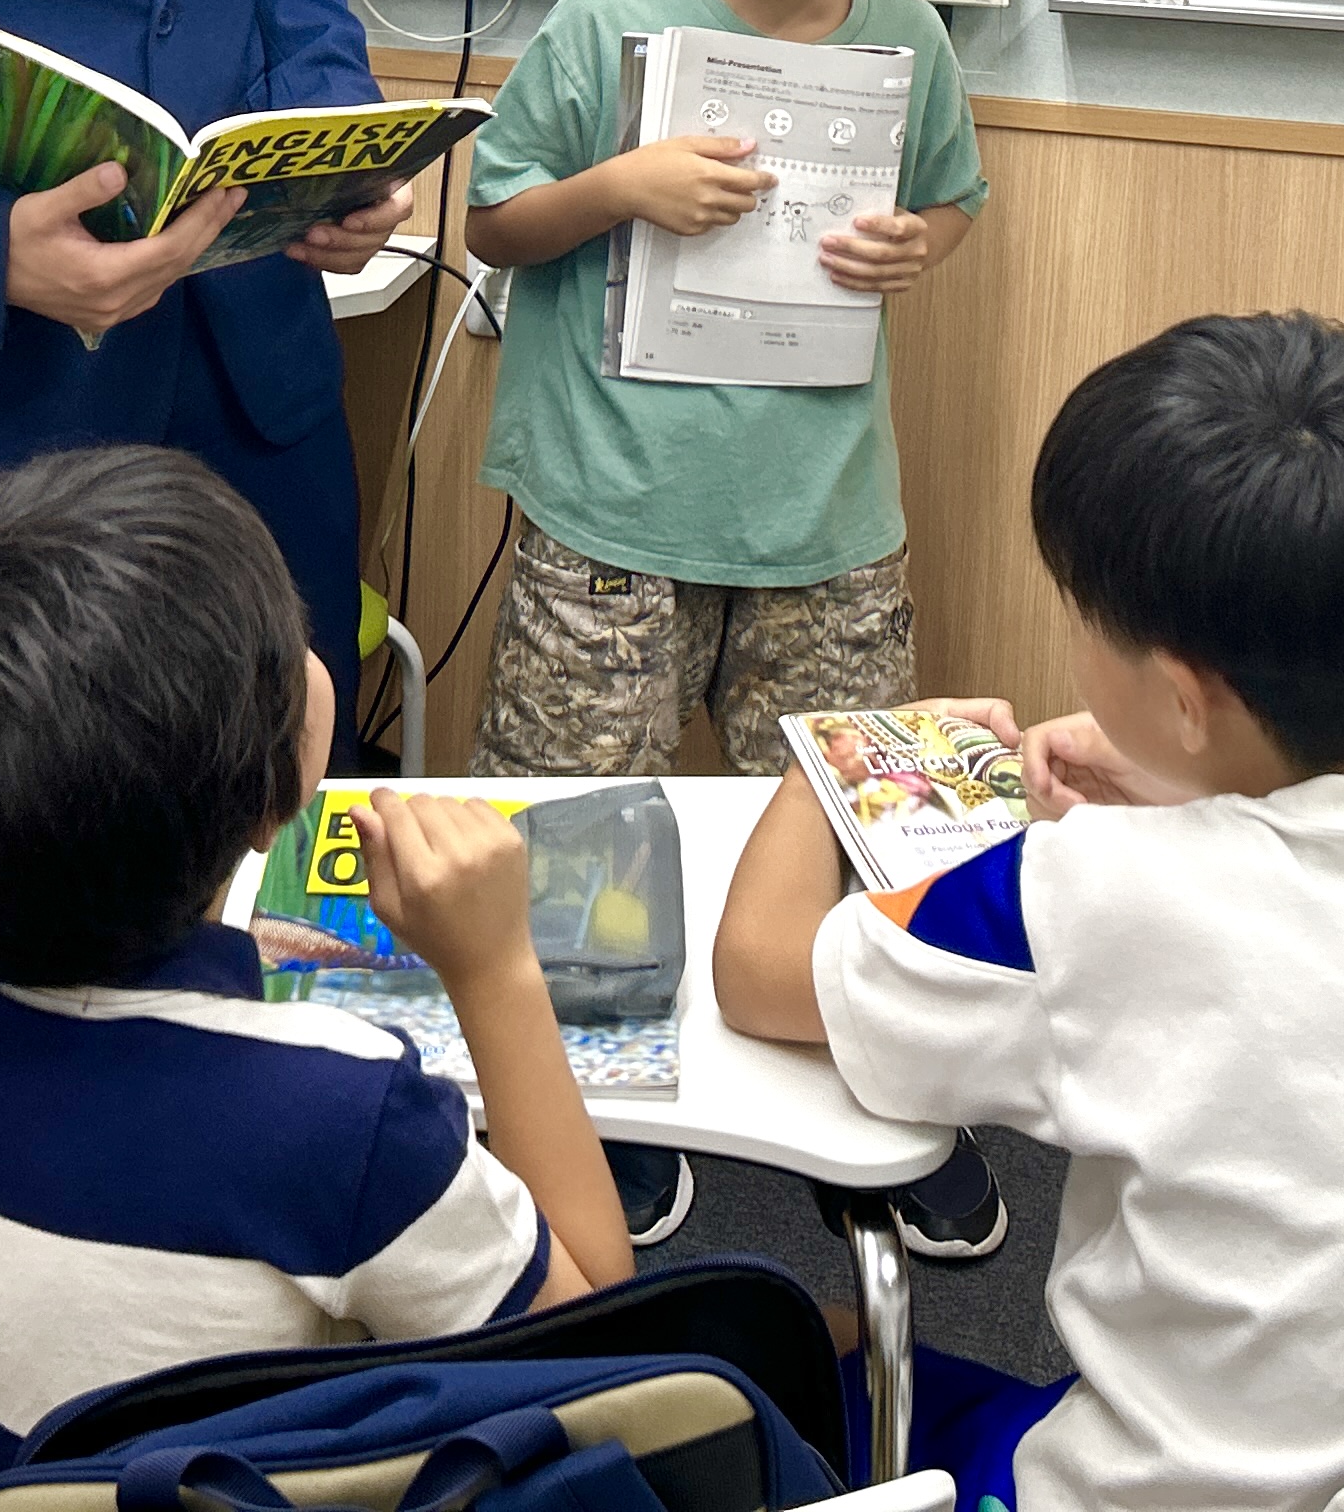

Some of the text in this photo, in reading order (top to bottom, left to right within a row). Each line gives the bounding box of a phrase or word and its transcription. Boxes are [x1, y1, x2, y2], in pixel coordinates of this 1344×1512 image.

[706, 56, 782, 75] Mini-Presentation
[203, 120, 427, 171] ENGLISH
[186, 140, 408, 198] OCEAN
[862, 752, 970, 778] Literacy
[900, 818, 1029, 838] Fabulous Face
